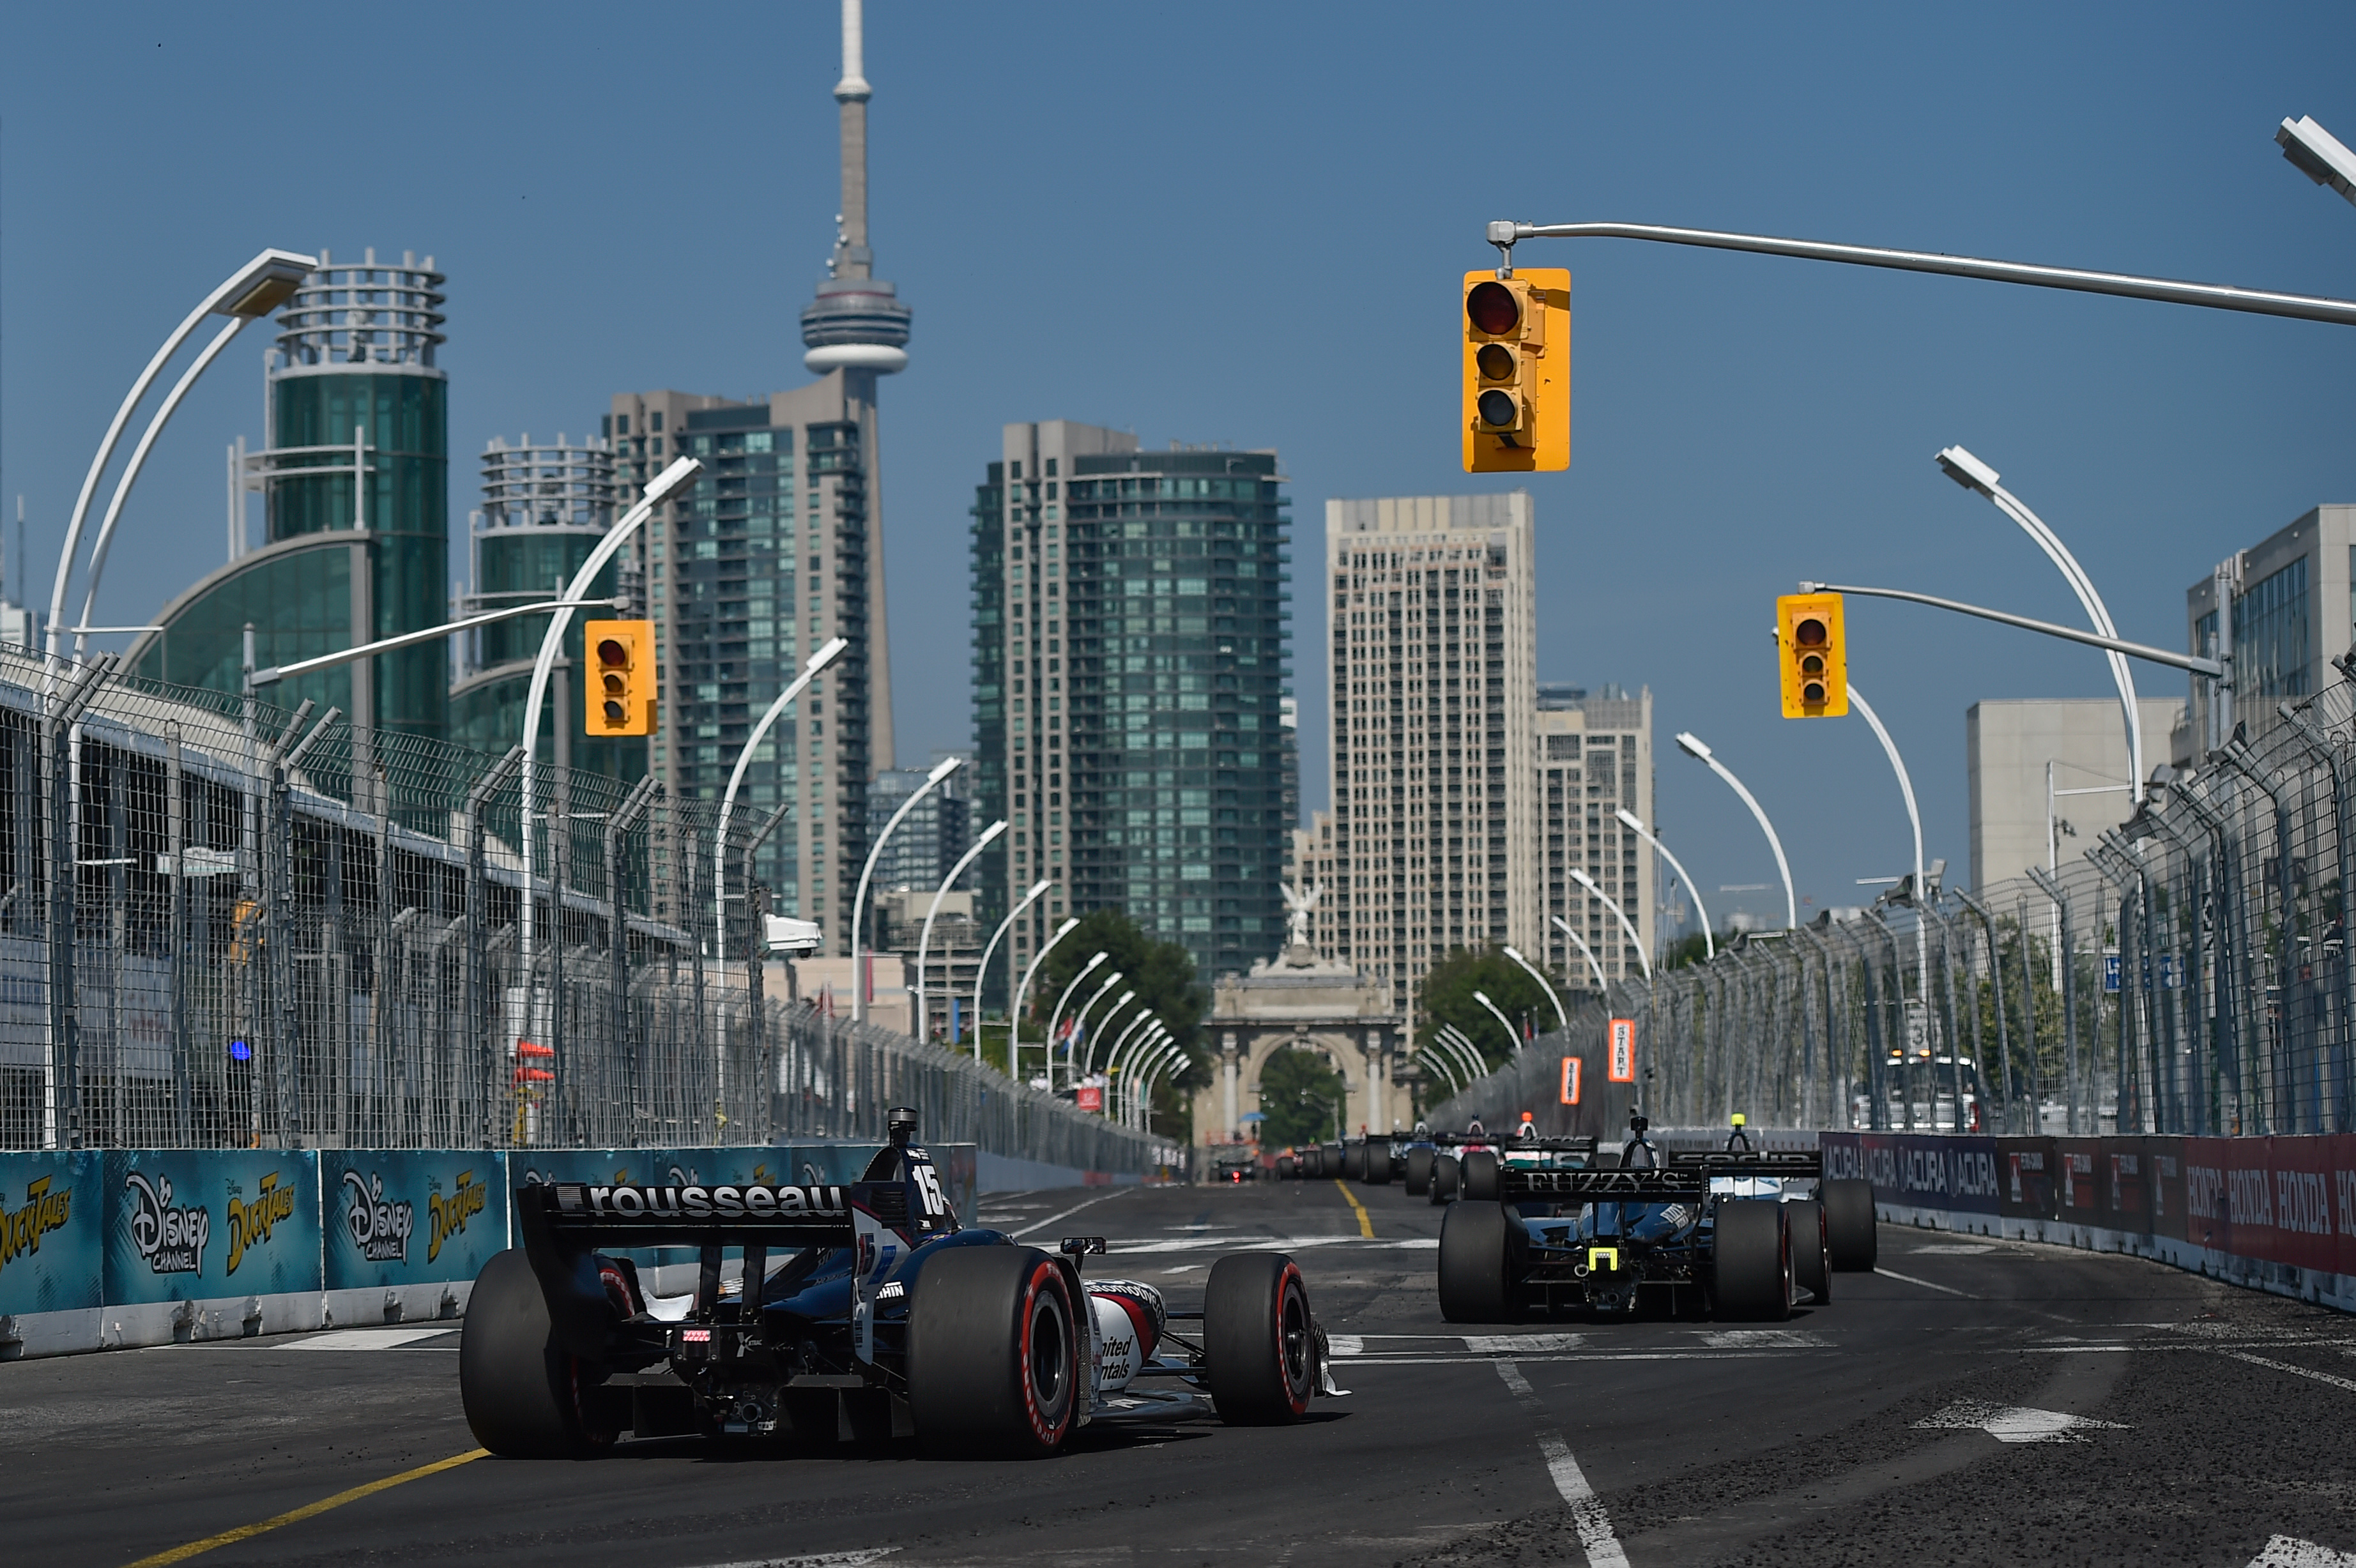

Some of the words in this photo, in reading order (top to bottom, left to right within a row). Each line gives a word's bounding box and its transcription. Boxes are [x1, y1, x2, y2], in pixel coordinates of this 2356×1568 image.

[1617, 1025, 1626, 1076] START
[912, 1165, 944, 1215] 15
[1907, 1150, 1948, 1193] ACURA
[1957, 1152, 2000, 1196] ACURA
[590, 1186, 847, 1217] rousseau
[2228, 1169, 2274, 1225] HONDA
[2276, 1170, 2332, 1235] HONDA
[152, 1251, 197, 1272] CHANNEL
[365, 1241, 402, 1260] CHANNEL
[875, 1285, 905, 1299] IHIN
[1102, 1335, 1133, 1357] nited
[1102, 1359, 1130, 1380] ntals
